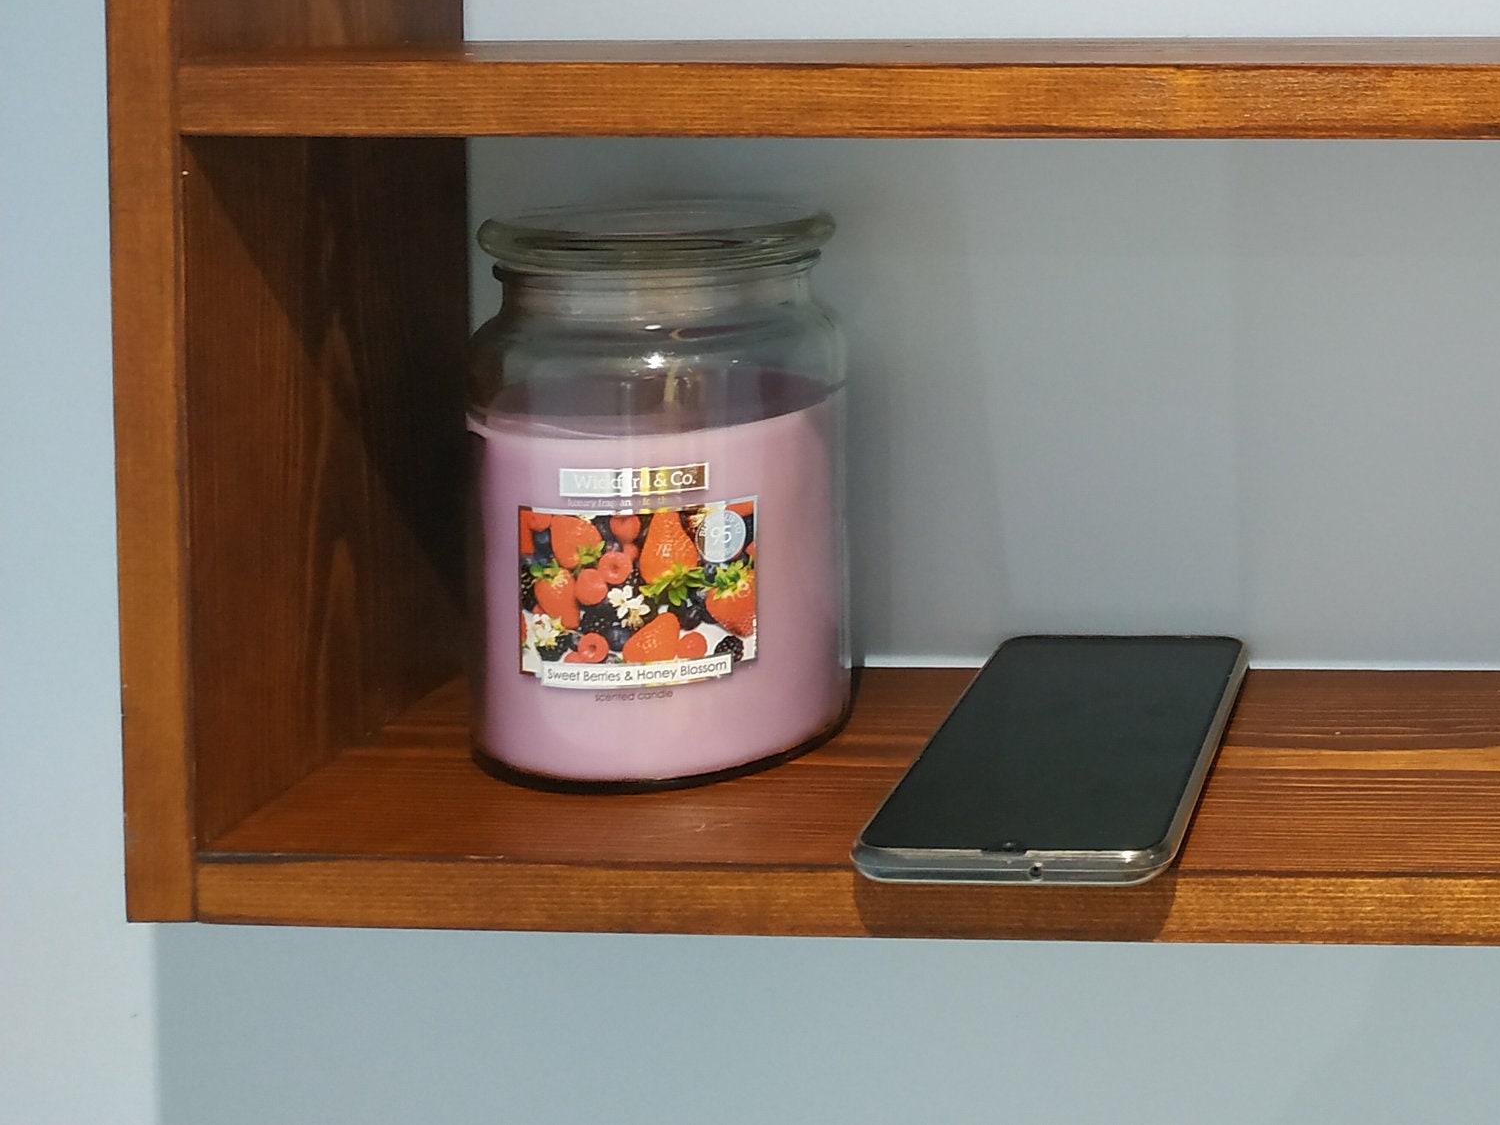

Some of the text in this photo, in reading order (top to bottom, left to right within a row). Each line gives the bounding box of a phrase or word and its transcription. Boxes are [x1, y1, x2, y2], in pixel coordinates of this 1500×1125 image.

[574, 470, 697, 490] Wickfrd & Co.
[710, 524, 732, 546] 95
[546, 659, 727, 684] Sweet Berries & Honey Blossom
[594, 689, 674, 702] scented candle
